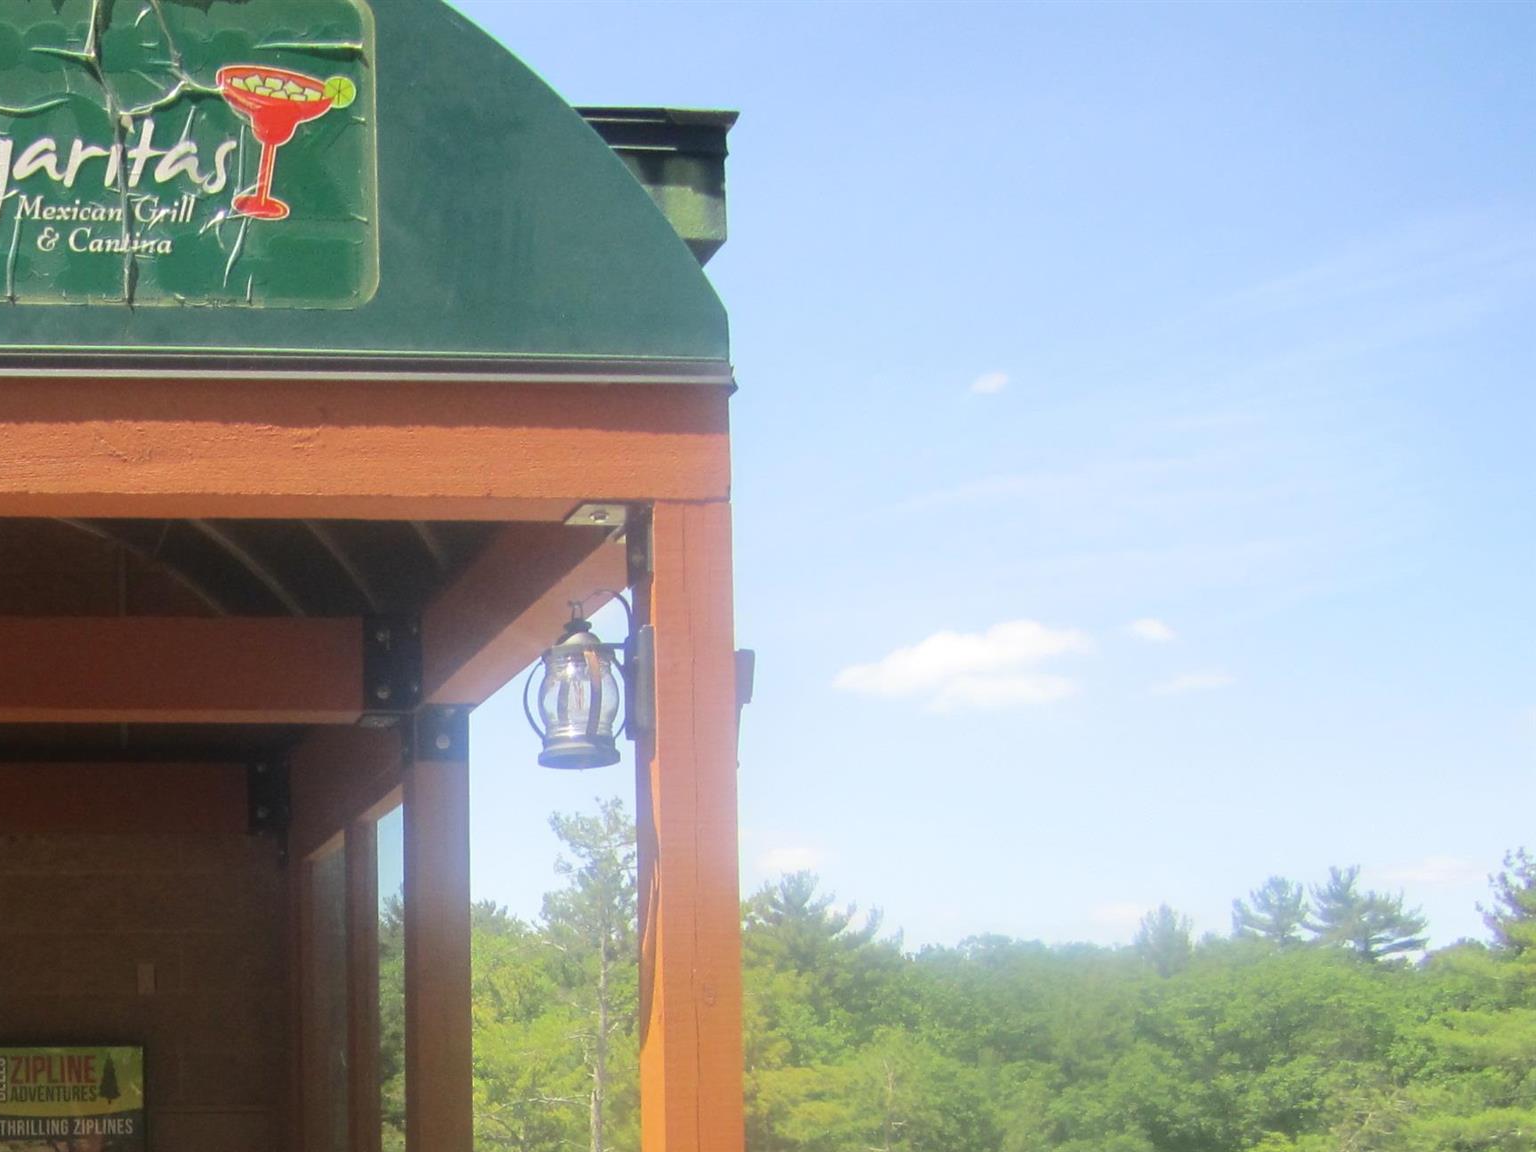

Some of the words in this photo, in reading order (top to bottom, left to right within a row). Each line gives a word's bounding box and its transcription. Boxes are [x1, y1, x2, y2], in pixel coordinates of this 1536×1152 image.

[14, 195, 123, 221] Mexican
[134, 194, 195, 222] Grill
[37, 227, 60, 252] &
[68, 227, 172, 253] Cantina
[10, 1055, 97, 1083] ZIPLINE
[10, 1085, 98, 1102] ADVENTURES
[0, 1119, 69, 1136] THRILLING
[73, 1118, 133, 1135] ZIPLINES
